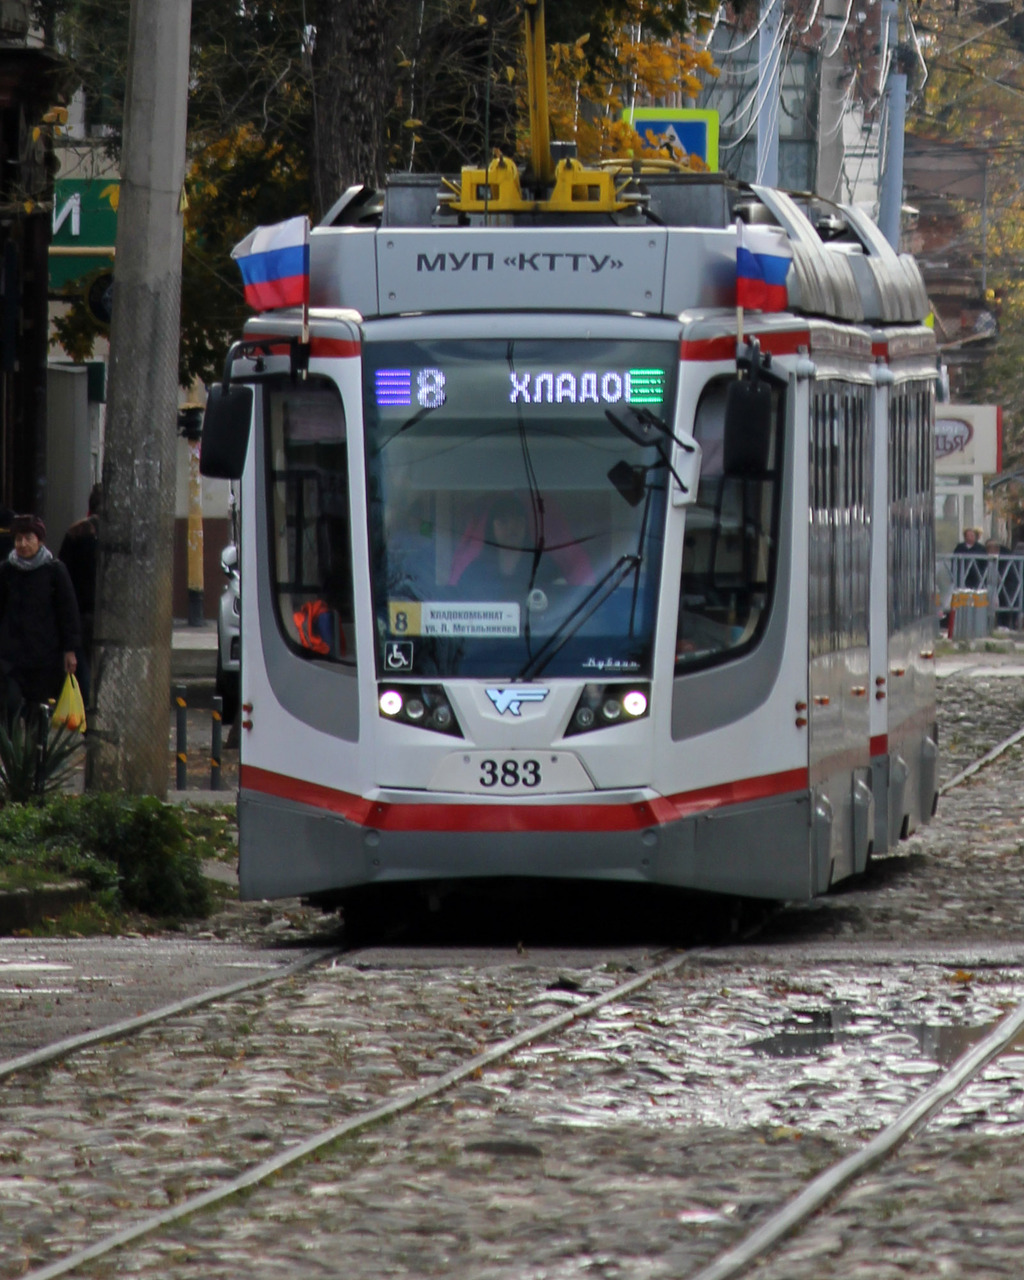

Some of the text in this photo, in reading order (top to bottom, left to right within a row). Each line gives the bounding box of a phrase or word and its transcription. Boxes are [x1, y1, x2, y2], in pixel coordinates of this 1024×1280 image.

[416, 252, 624, 273] МУП «КТТУ»
[416, 368, 446, 408] 8
[395, 611, 408, 632] 8
[430, 610, 503, 621] ХЛАДОКОМБИНАТ
[453, 623, 517, 633] Метальникова
[480, 759, 541, 788] 383
